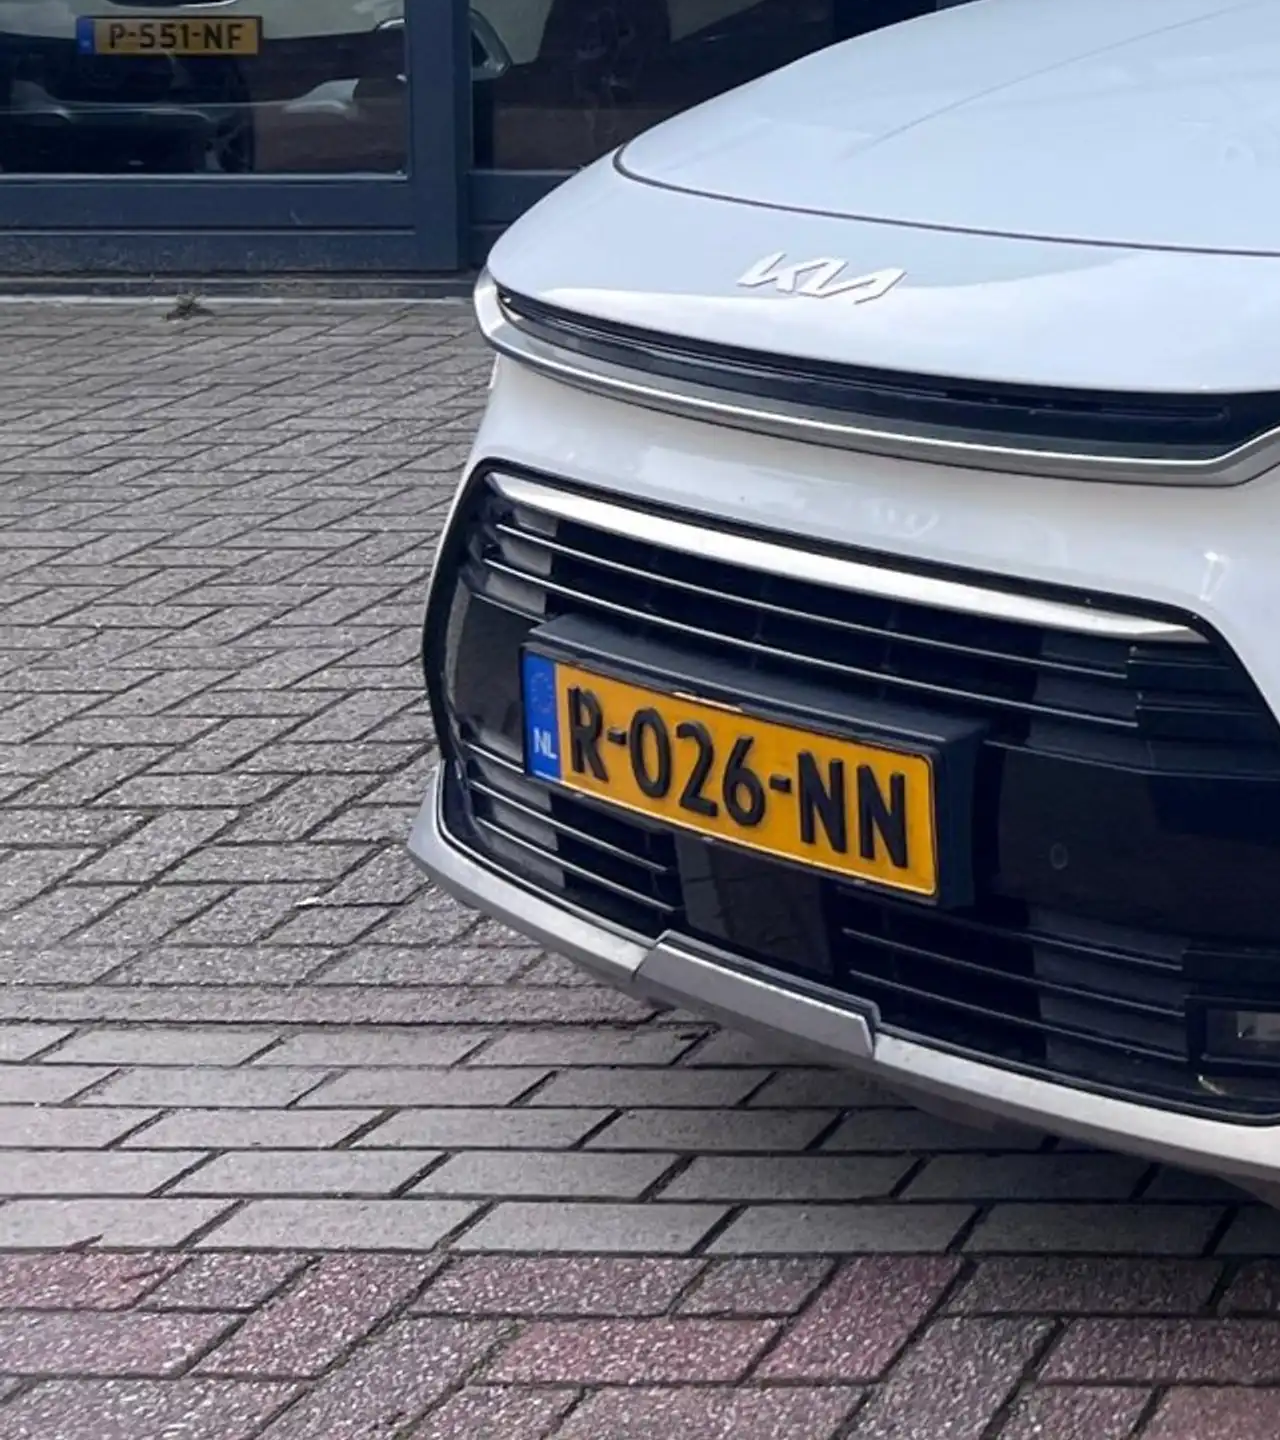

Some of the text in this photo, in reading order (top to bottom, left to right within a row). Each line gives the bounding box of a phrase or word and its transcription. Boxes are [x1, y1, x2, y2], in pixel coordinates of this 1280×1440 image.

[109, 22, 245, 50] P-551-NF
[735, 250, 908, 305] KIA
[533, 726, 558, 760] NL
[567, 684, 909, 868] R-026-NN
